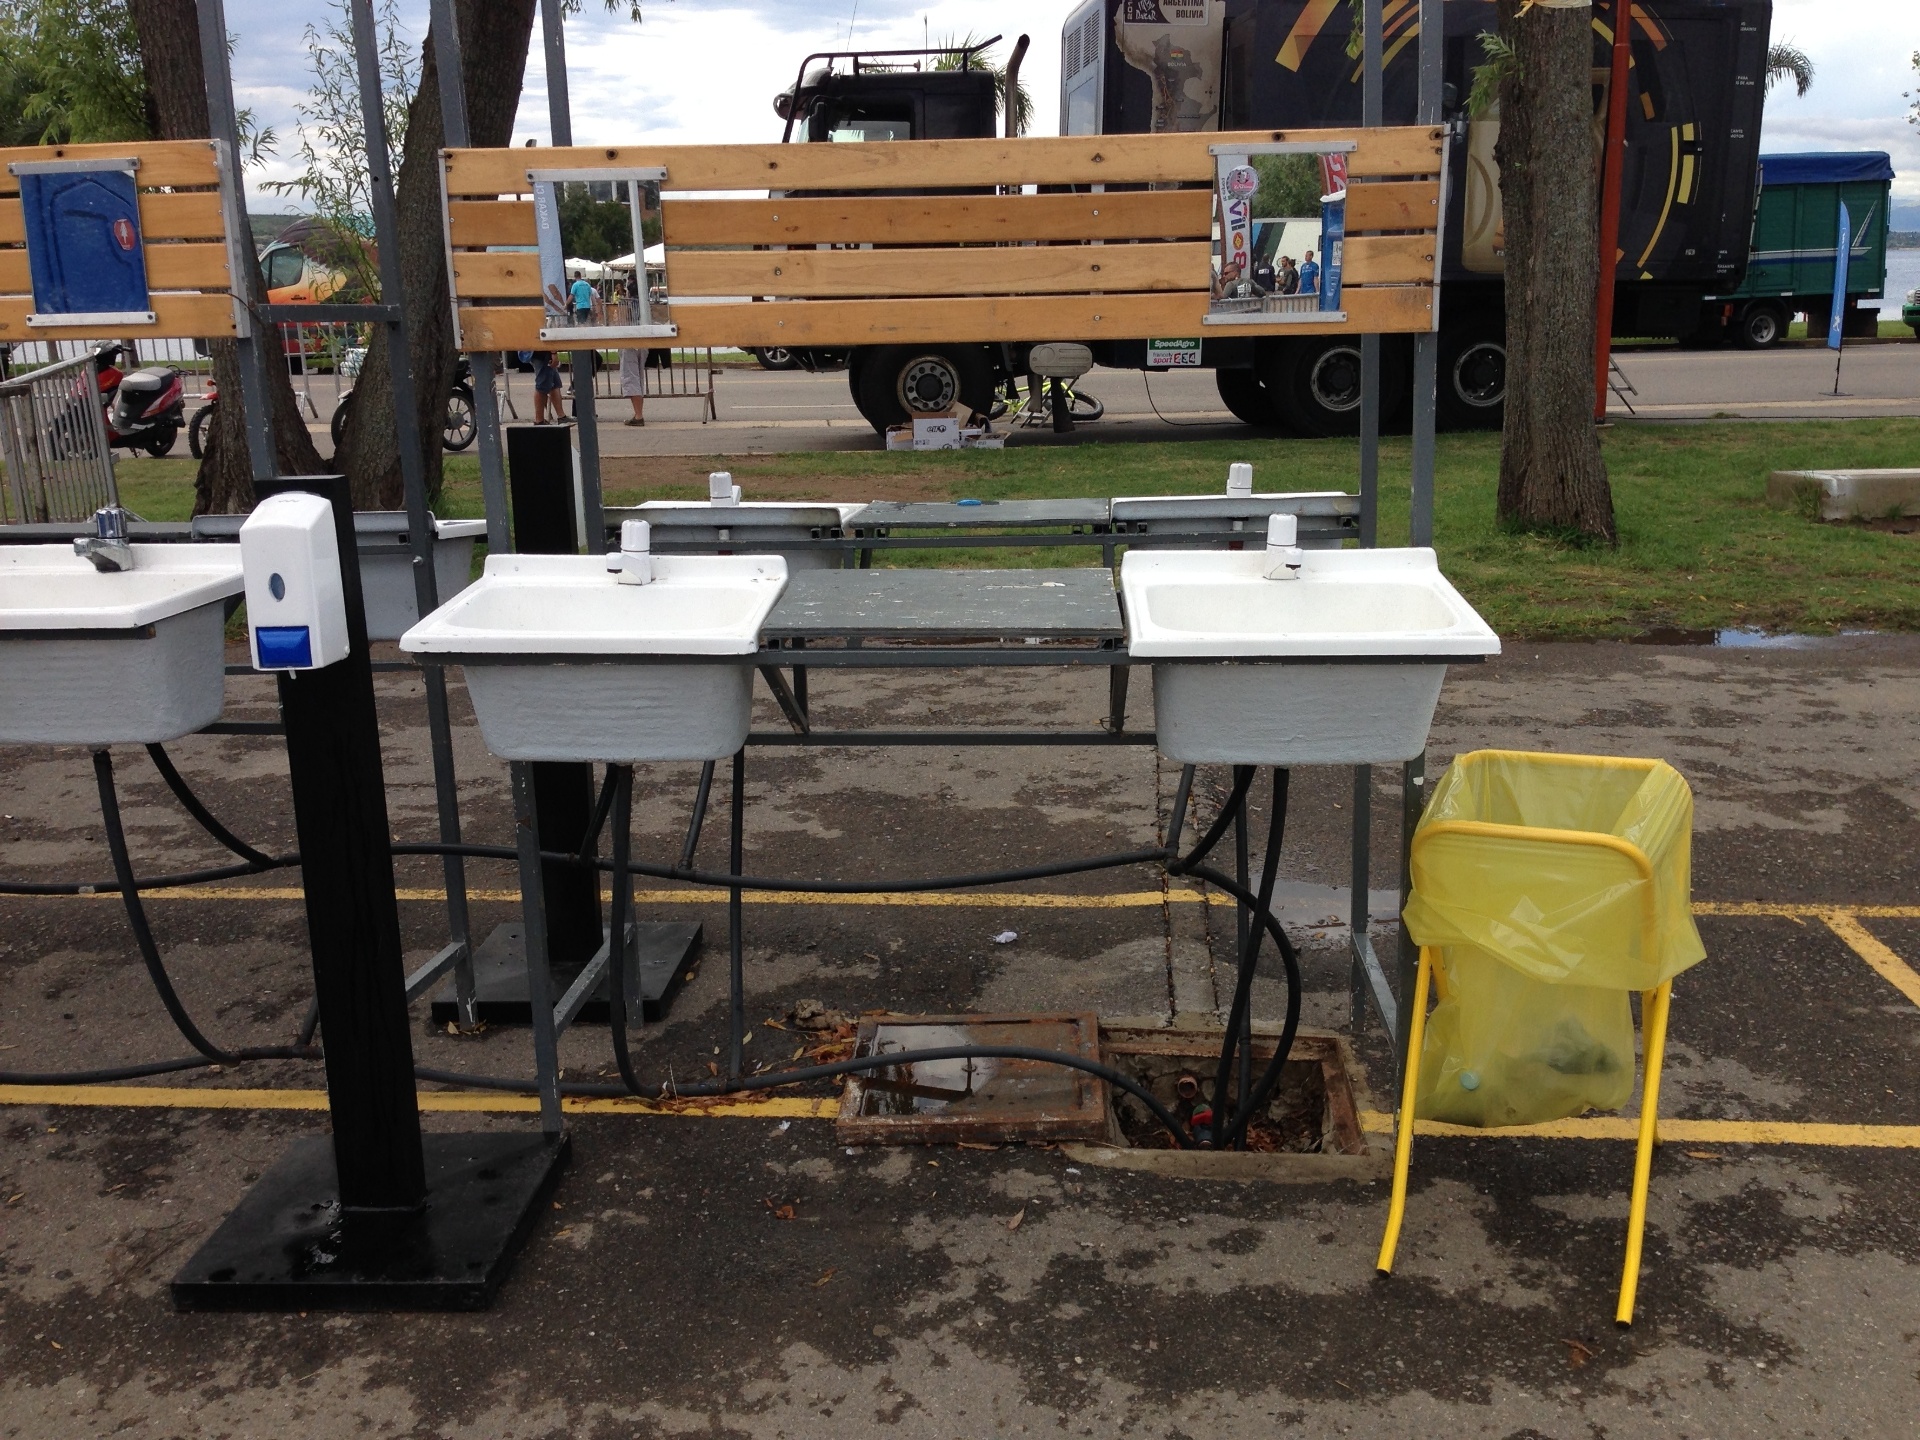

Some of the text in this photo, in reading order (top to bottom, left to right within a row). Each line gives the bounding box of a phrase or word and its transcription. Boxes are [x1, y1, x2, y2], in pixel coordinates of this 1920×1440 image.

[1175, 9, 1204, 19] BOLIVIA
[1155, 340, 1195, 348] SpeedAgro
[1152, 357, 1173, 365] sport
